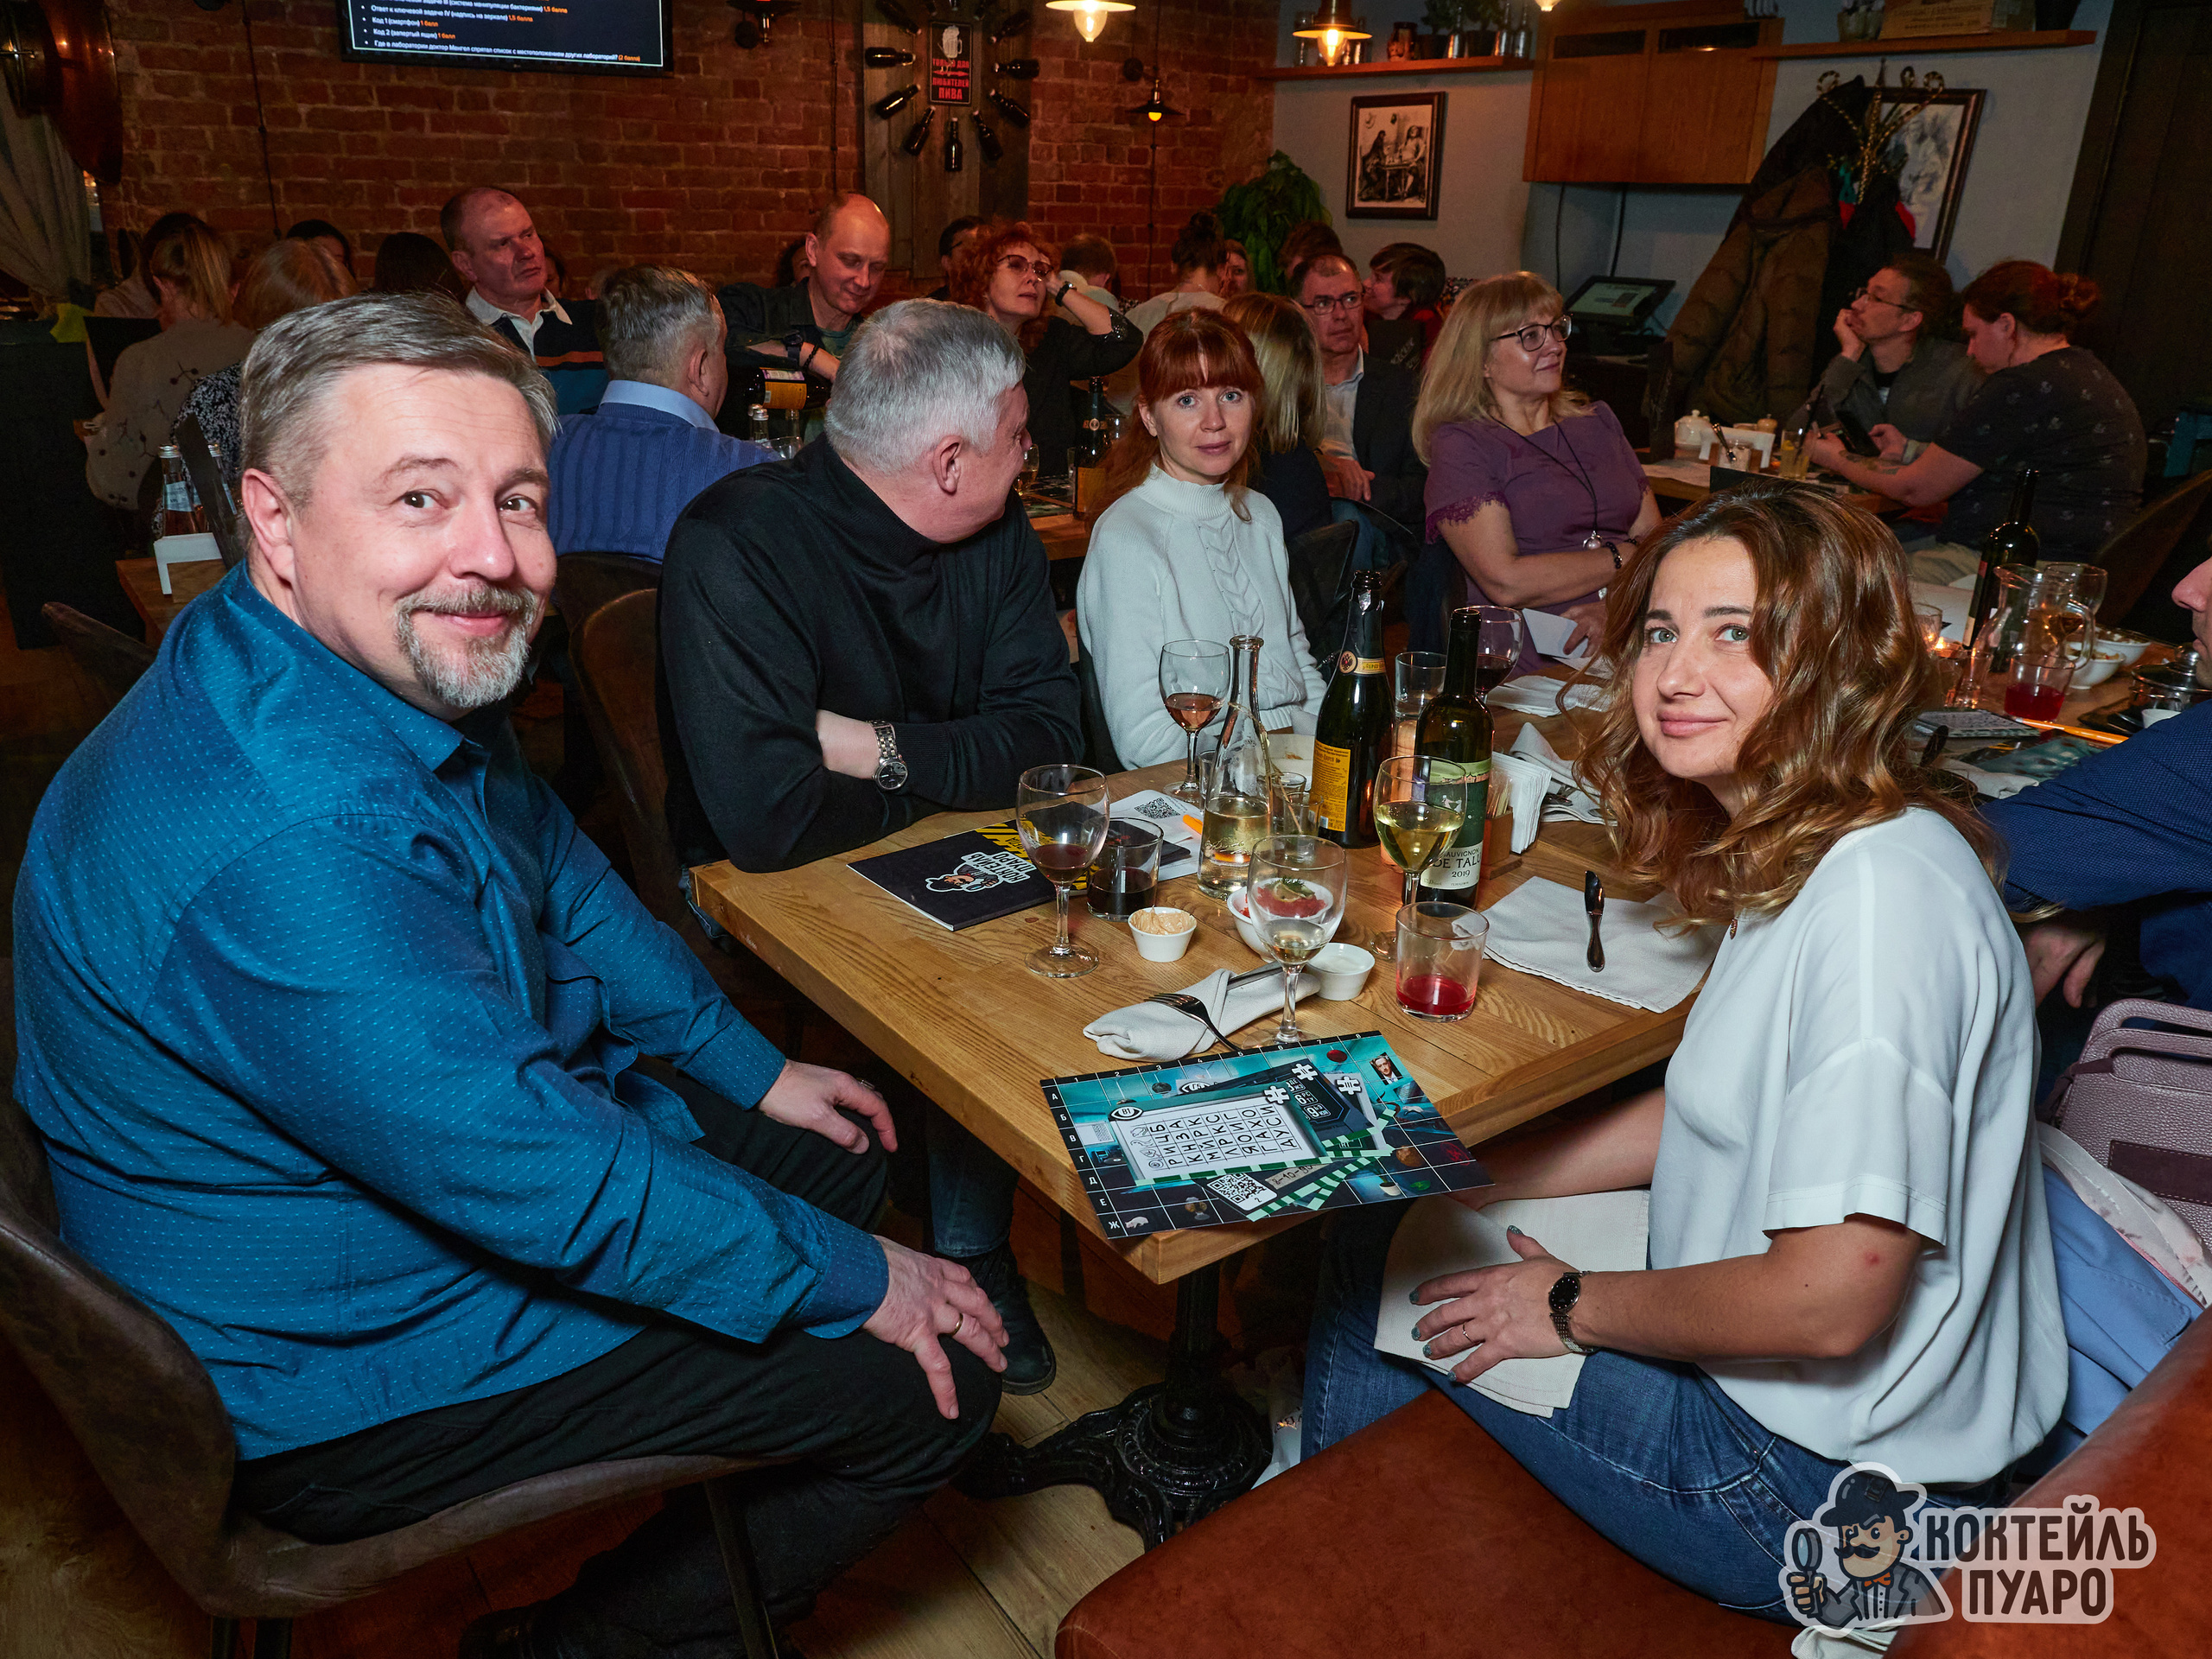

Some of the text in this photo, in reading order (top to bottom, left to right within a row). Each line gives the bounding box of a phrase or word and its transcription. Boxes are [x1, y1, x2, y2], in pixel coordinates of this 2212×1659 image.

[389, 17, 420, 27] (смартфон)
[932, 77, 969, 88] ЛЮБИТЕЛЕЙ
[938, 87, 963, 100] ПИВА
[1444, 848, 1480, 858] AUVIGNON
[968, 853, 1025, 882] КОКТЕЙЛЬ
[992, 853, 1035, 874] ПУАРО
[1452, 869, 1471, 878] 2019
[1294, 1094, 1307, 1105] 6
[1306, 1107, 1320, 1117] 9
[1089, 1177, 1098, 1185] Д
[1109, 1221, 1121, 1230] Ж
